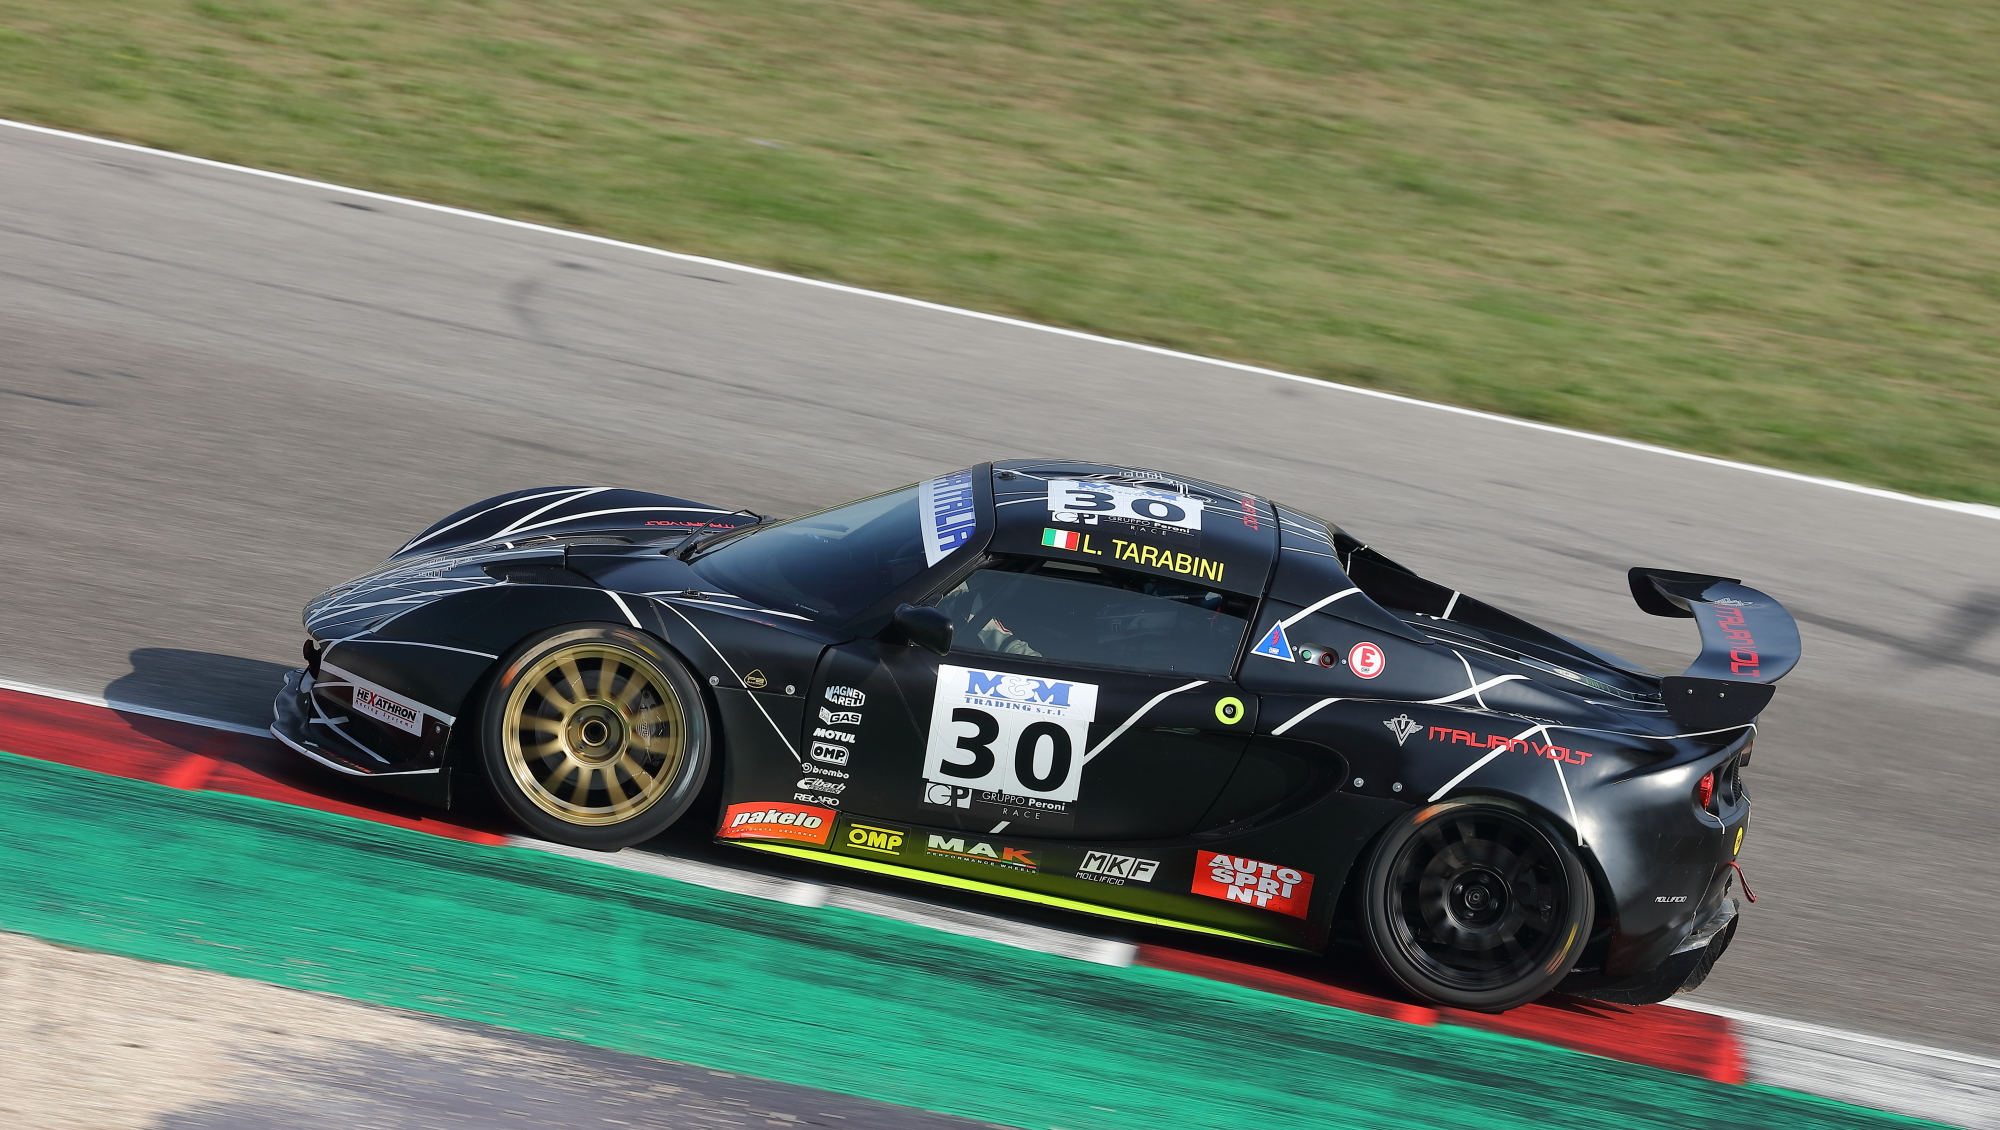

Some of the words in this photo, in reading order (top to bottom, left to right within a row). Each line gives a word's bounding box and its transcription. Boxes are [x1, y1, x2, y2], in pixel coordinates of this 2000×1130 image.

[1063, 490, 1187, 522] 30
[1107, 515, 1151, 527] GRUPPO
[1153, 521, 1191, 535] Peroni
[1130, 525, 1168, 537] RACE
[1082, 533, 1103, 556] L.
[1112, 538, 1225, 583] TARABINI
[1360, 646, 1376, 668] E
[964, 670, 1074, 708] M&M
[356, 688, 417, 723] HEXATHRON
[964, 695, 1032, 712] TRADING
[1036, 706, 1066, 717] s.r.l.
[829, 713, 860, 724] GAS
[812, 727, 856, 744] MOTUL
[1427, 725, 1529, 755] ITALIAN
[1530, 740, 1594, 766] VOLT
[813, 744, 846, 763] OMP
[938, 707, 1073, 793] 30
[811, 765, 850, 779] brembo
[793, 792, 840, 807] RECARO
[981, 789, 1026, 806] GRUPPO
[1027, 797, 1066, 812] Peroni
[730, 808, 823, 830] pakelo
[1002, 807, 1041, 821] RACE
[848, 827, 903, 851] OMP
[927, 833, 1037, 866] MAK
[926, 851, 996, 867] PERFORMANCE
[1000, 863, 1036, 874] WHEELS
[1081, 850, 1158, 881] MKF
[1207, 853, 1303, 886] AUTO
[1075, 870, 1125, 887] MOLLIFICIO
[1210, 867, 1294, 899] SPRI
[1225, 884, 1273, 909] NT
